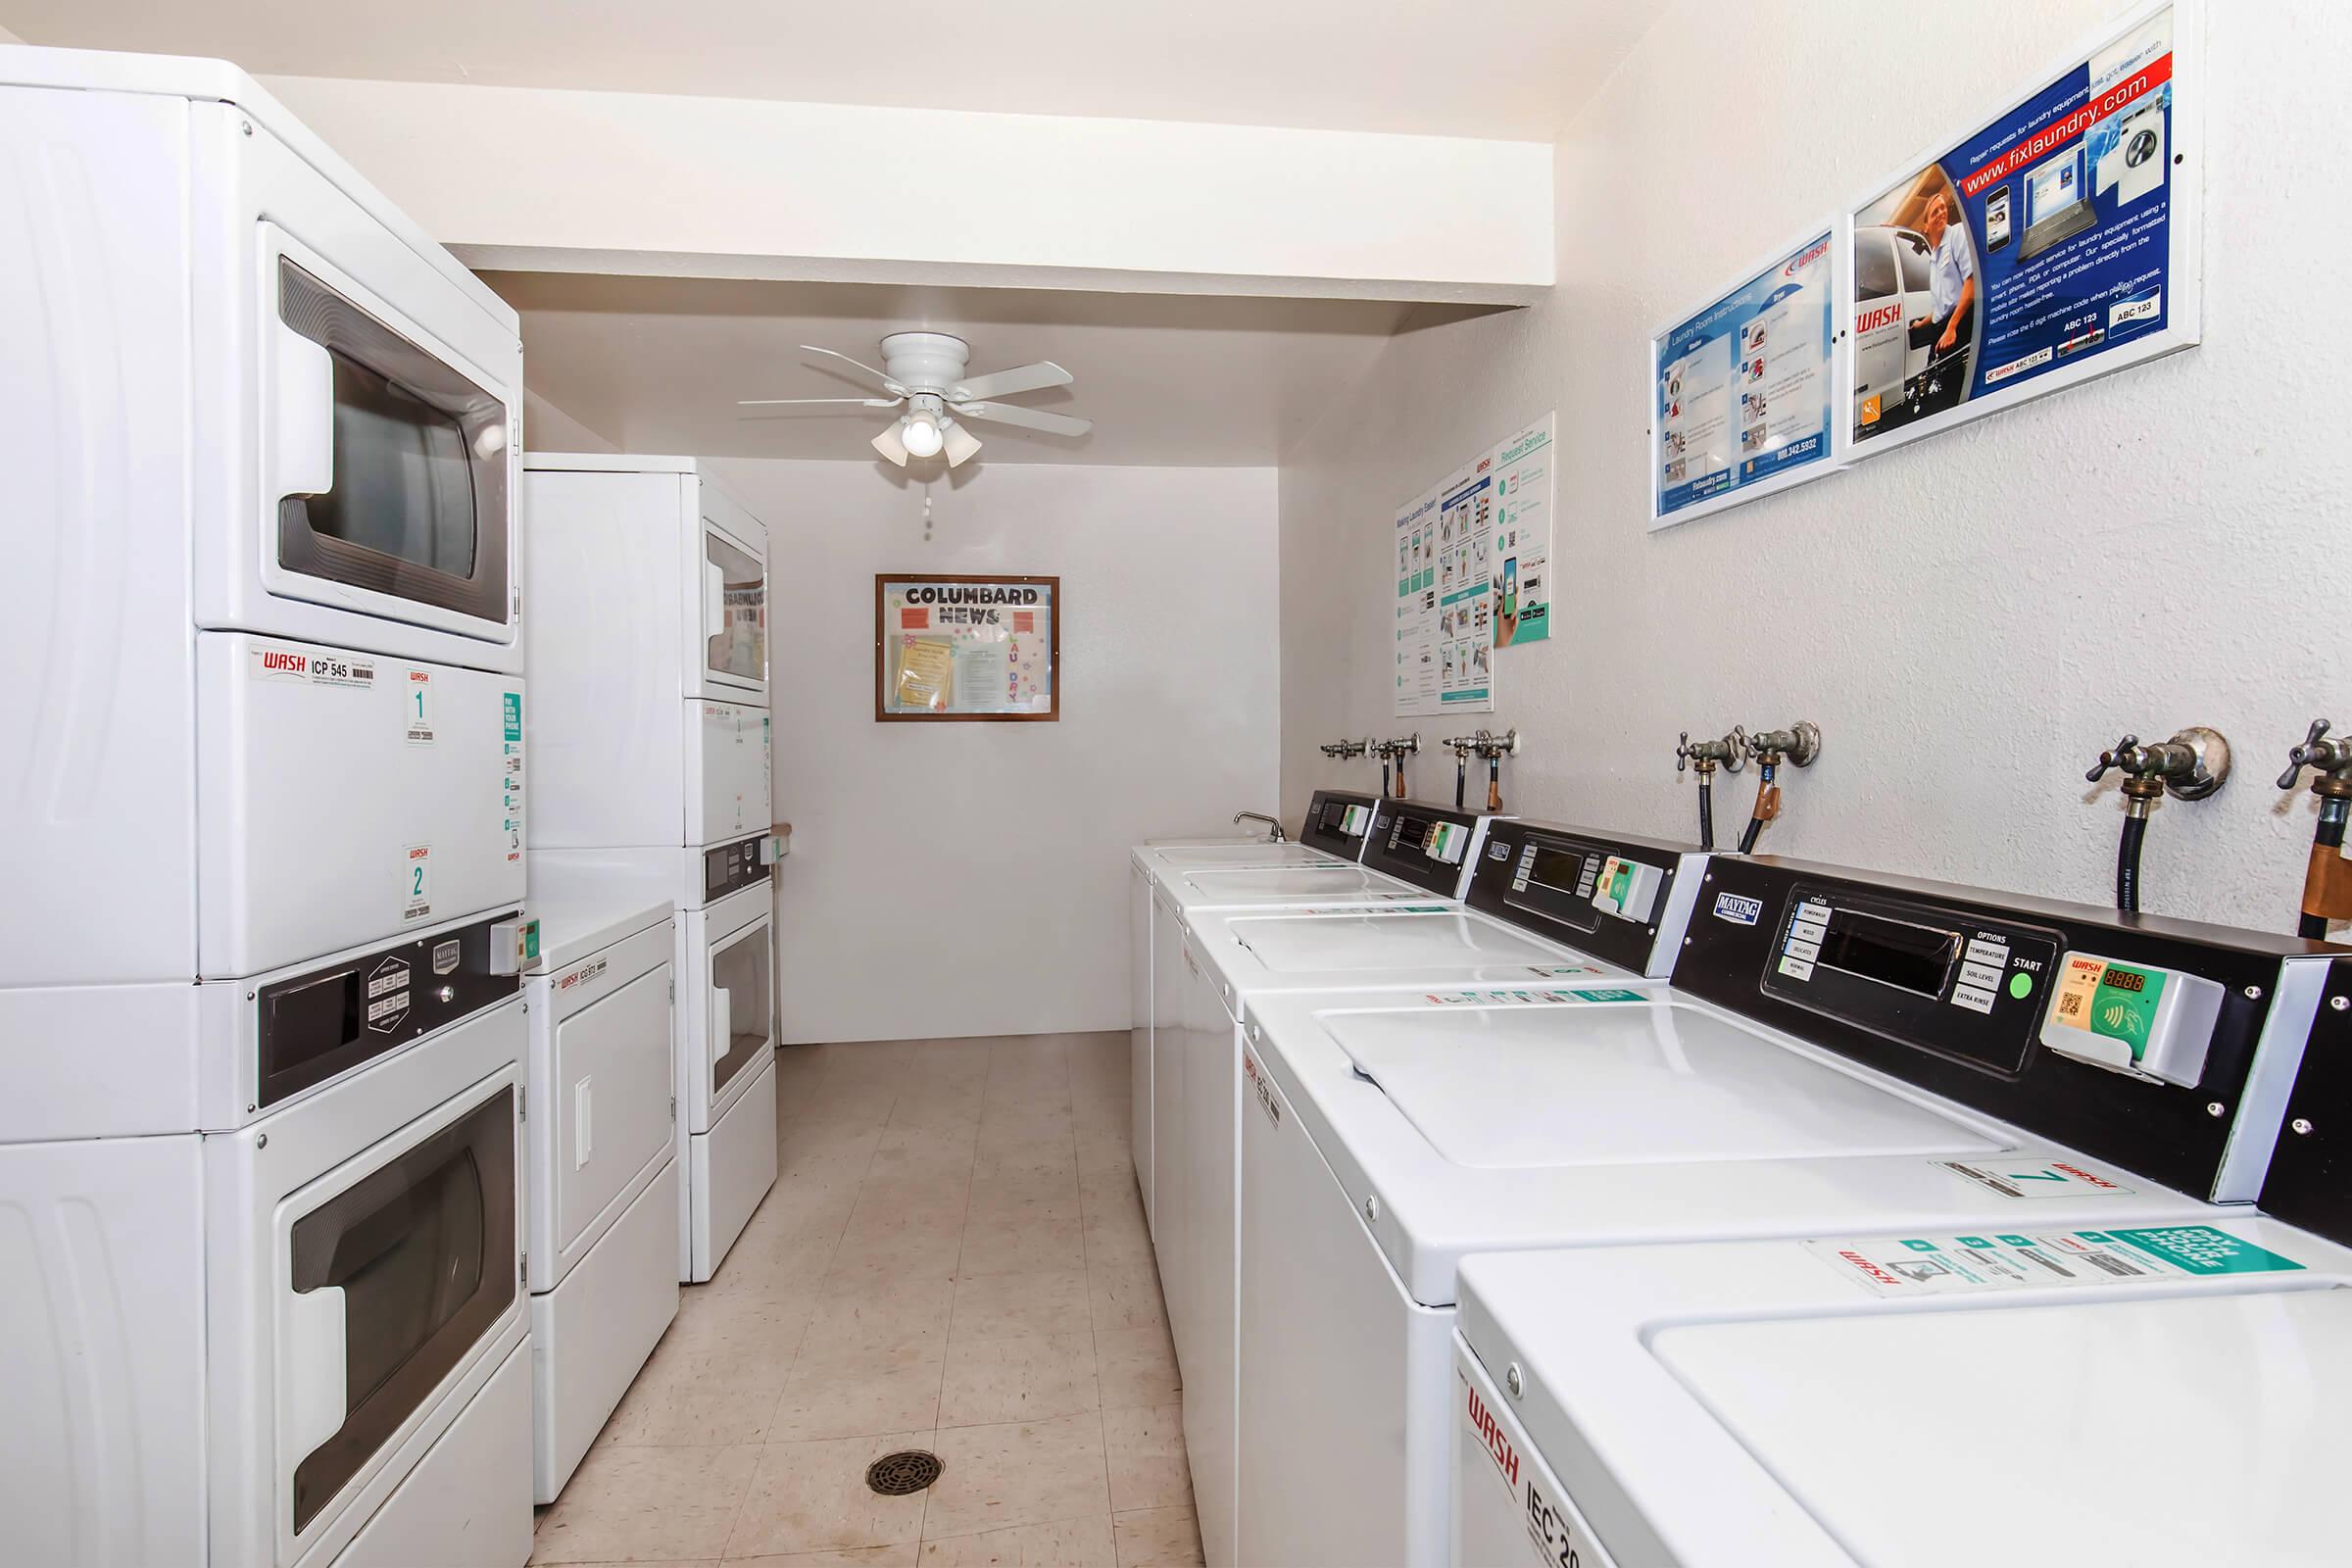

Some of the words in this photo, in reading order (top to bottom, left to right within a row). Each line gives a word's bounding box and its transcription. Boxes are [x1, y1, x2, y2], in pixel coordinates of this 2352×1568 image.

[2018, 124, 2027, 135] for
[2028, 108, 2051, 128] laundry
[2052, 86, 2090, 114] equipment
[2067, 243, 2078, 253] for
[2078, 231, 2102, 248] laundry
[2104, 214, 2139, 236] equipment
[2140, 205, 2159, 219] using
[1798, 241, 1828, 268] WASH
[2029, 272, 2040, 284] PDA
[2085, 247, 2098, 257] Our
[2101, 232, 2130, 250] specially
[2132, 214, 2166, 235] formatted
[2036, 275, 2062, 292] reporting
[2068, 261, 2094, 278] problem
[2095, 250, 2120, 266] directly
[2121, 241, 2137, 254] from
[2138, 236, 2150, 246] the
[2009, 306, 2024, 317] room
[2047, 305, 2072, 320] machine
[2073, 299, 2089, 310] code
[2089, 290, 2108, 303] when
[2117, 308, 2135, 321] ABC
[2137, 301, 2152, 314] 123
[1671, 328, 1694, 346] Laundry
[1694, 316, 1713, 330] Room
[1714, 293, 1752, 320] Instructions
[1857, 303, 1901, 333] WASH
[2063, 318, 2082, 332] ABC
[2083, 312, 2097, 324] 123
[2015, 358, 2028, 368] ABC
[1500, 447, 1525, 463] Request
[1524, 430, 1546, 450] Service
[906, 587, 1039, 607] COLUMBARD
[939, 607, 1001, 625] NEWS
[264, 651, 307, 672] WASH
[312, 660, 328, 675] ICP
[331, 662, 347, 677] 545
[410, 671, 429, 683] WASH
[416, 690, 423, 718] 1
[409, 848, 428, 859] WASH
[414, 866, 423, 896] 2
[1718, 896, 1757, 916] MAYTAG
[1810, 897, 1828, 906] CYCLES
[1977, 931, 2007, 944] OPTIONS
[1970, 947, 2006, 960] TEMPERATURE
[2013, 957, 2043, 971] START
[1966, 970, 1978, 979] SOIL
[1978, 973, 1994, 983] LEVEL
[2072, 959, 2102, 973] WASH
[1956, 992, 1974, 1002] EXTRA
[1974, 996, 1989, 1006] RINSE
[2007, 1169, 2071, 1182] 7
[2050, 1163, 2118, 1189] WASH
[2156, 1231, 2224, 1258] YOUR
[2172, 1230, 2240, 1255] WITH
[2187, 1229, 2241, 1247] PAY
[2135, 1232, 2225, 1267] PHONE
[1838, 1250, 1902, 1285] WASH
[1468, 1386, 1519, 1487] WASH
[1527, 1480, 1554, 1544] IEC
